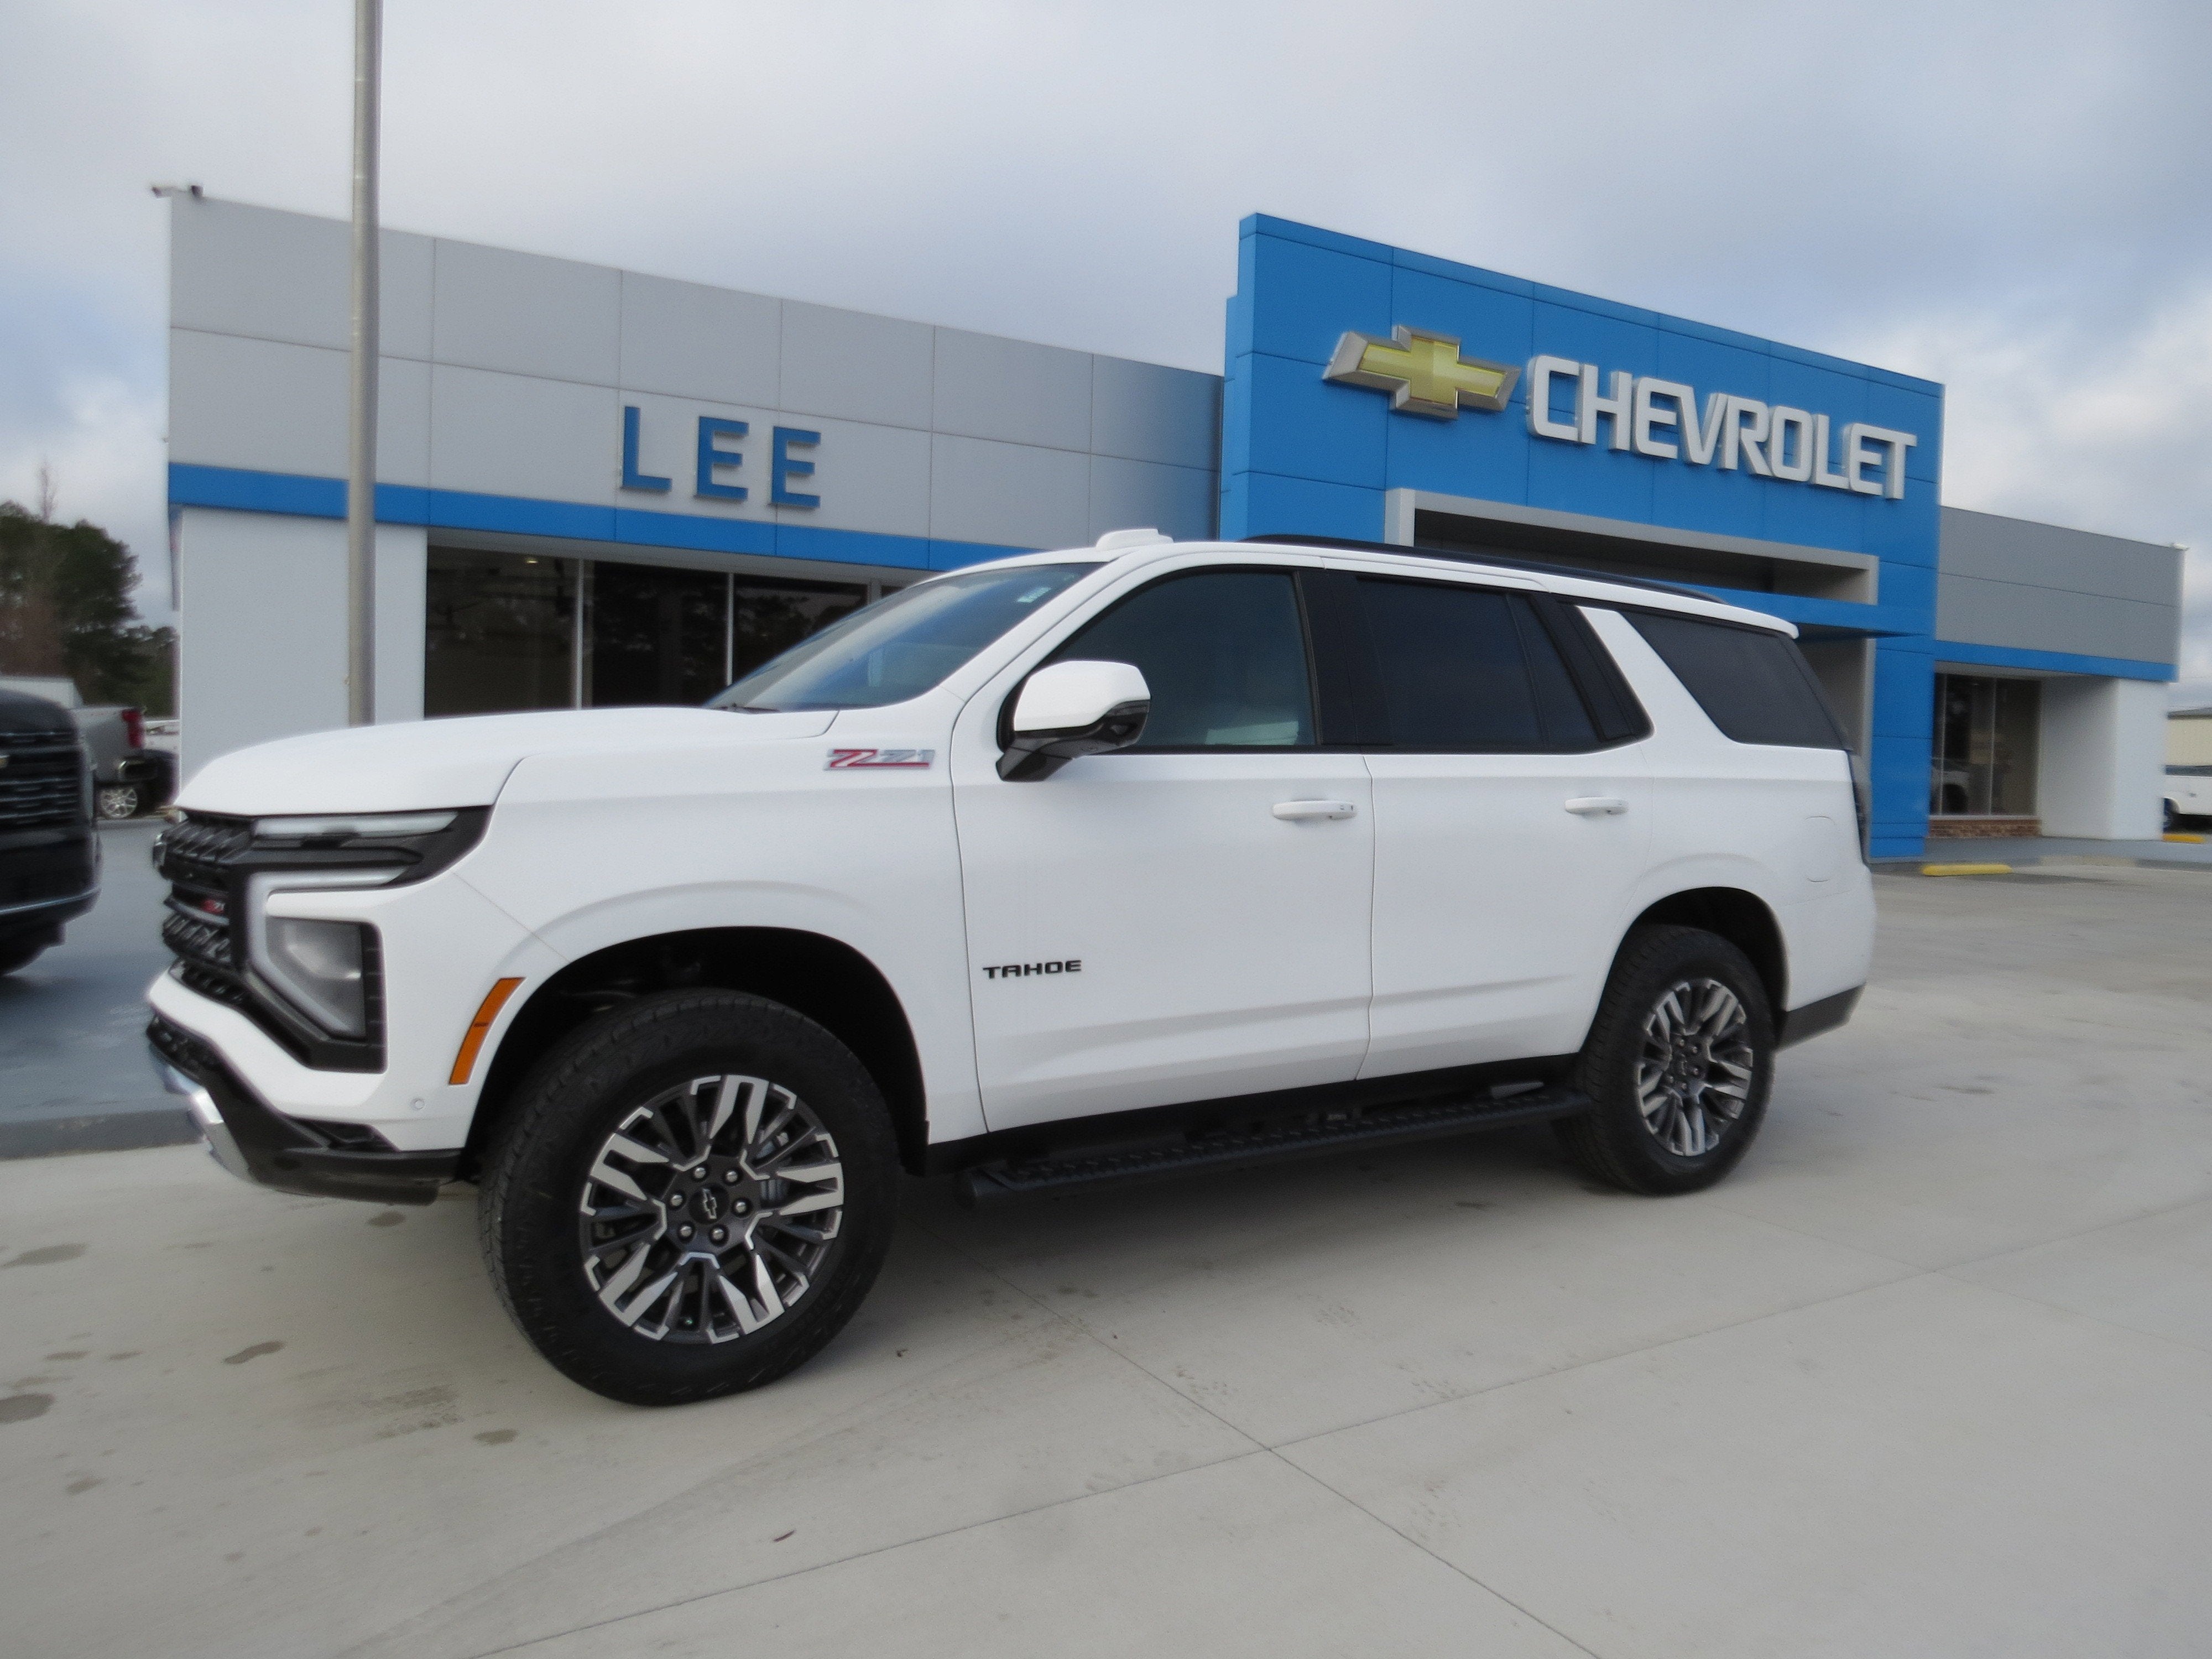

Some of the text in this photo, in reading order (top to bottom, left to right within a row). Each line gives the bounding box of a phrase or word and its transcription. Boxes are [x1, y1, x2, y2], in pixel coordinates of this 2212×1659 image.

[622, 405, 821, 509] LEE
[1528, 354, 1917, 500] CHEVROLET
[825, 749, 936, 771] Z71
[983, 960, 1082, 979] TAHOE
